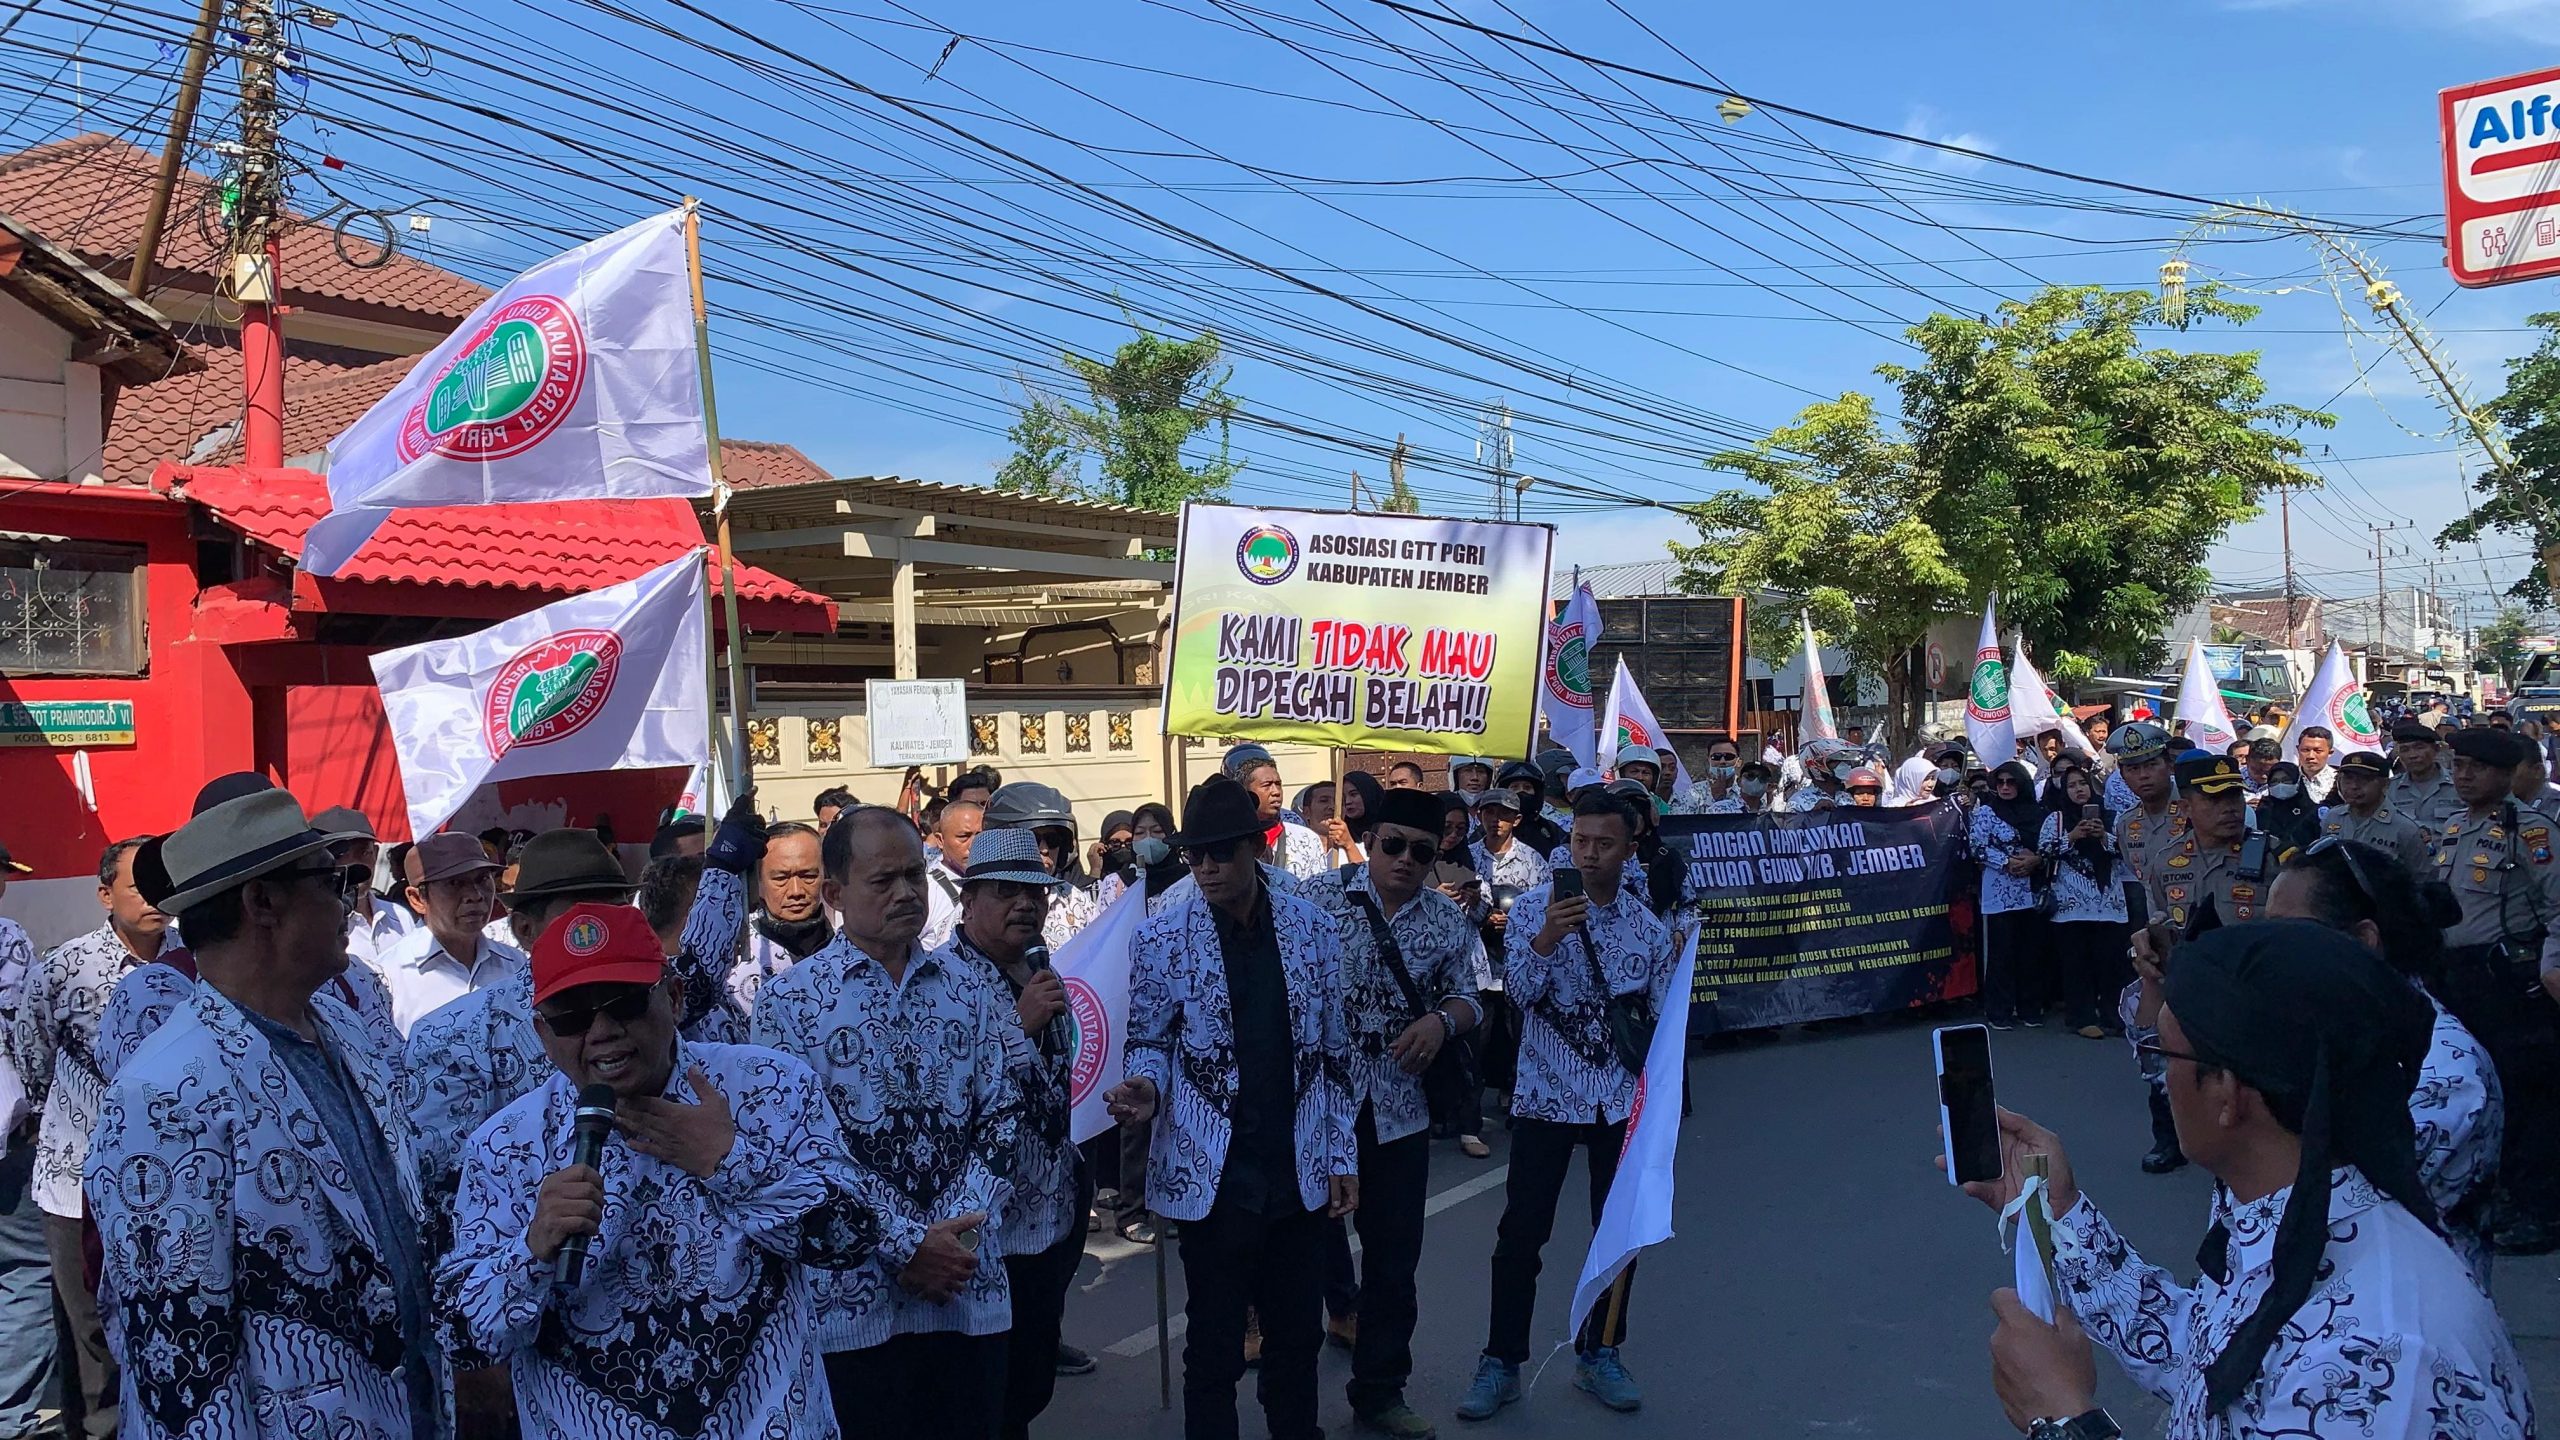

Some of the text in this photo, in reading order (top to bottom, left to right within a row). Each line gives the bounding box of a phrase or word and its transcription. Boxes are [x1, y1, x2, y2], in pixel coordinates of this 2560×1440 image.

[1308, 534, 1486, 566] ASOSIASI GTT PGRI
[1306, 563, 1489, 595] KABUPATEN JEMBER
[1218, 611, 1495, 680] KAMI TIDAK MAU
[1215, 668, 1491, 733] DIPECAH BELAH!!
[1566, 692, 1593, 704] ONESIA
[120, 709, 130, 725] VI
[14, 734, 48, 742] KODE
[51, 734, 74, 742] POS
[890, 740, 925, 751] KALIWATES
[929, 739, 953, 750] JEMBER
[1689, 830, 1767, 859] JANGAN
[2476, 838, 2507, 853] POLRI
[1690, 860, 1755, 888] ATUAN
[1758, 858, 1804, 885] GURU
[1847, 844, 1926, 876] JEMBER
[1735, 895, 1780, 908] PERSATUAN
[1811, 888, 1843, 901] JEMBER
[1700, 928, 1721, 939] ASET
[1845, 914, 1874, 927] BUKAN
[1876, 909, 1910, 923] DICERAI
[1711, 912, 1743, 924] SUDAH
[1745, 910, 1768, 923] SOLID
[1769, 908, 1794, 921] JANGAN
[1824, 902, 1852, 914] BELAH
[1696, 943, 1735, 956] ERKUASA
[1772, 952, 1798, 966] JANGAN
[1799, 949, 1829, 963] DIUSIK
[1830, 939, 1910, 959] KETENTRAMANNYA
[1791, 961, 1854, 979] OKNUM-OKNUM
[1858, 952, 1921, 970] MENGKAMBING
